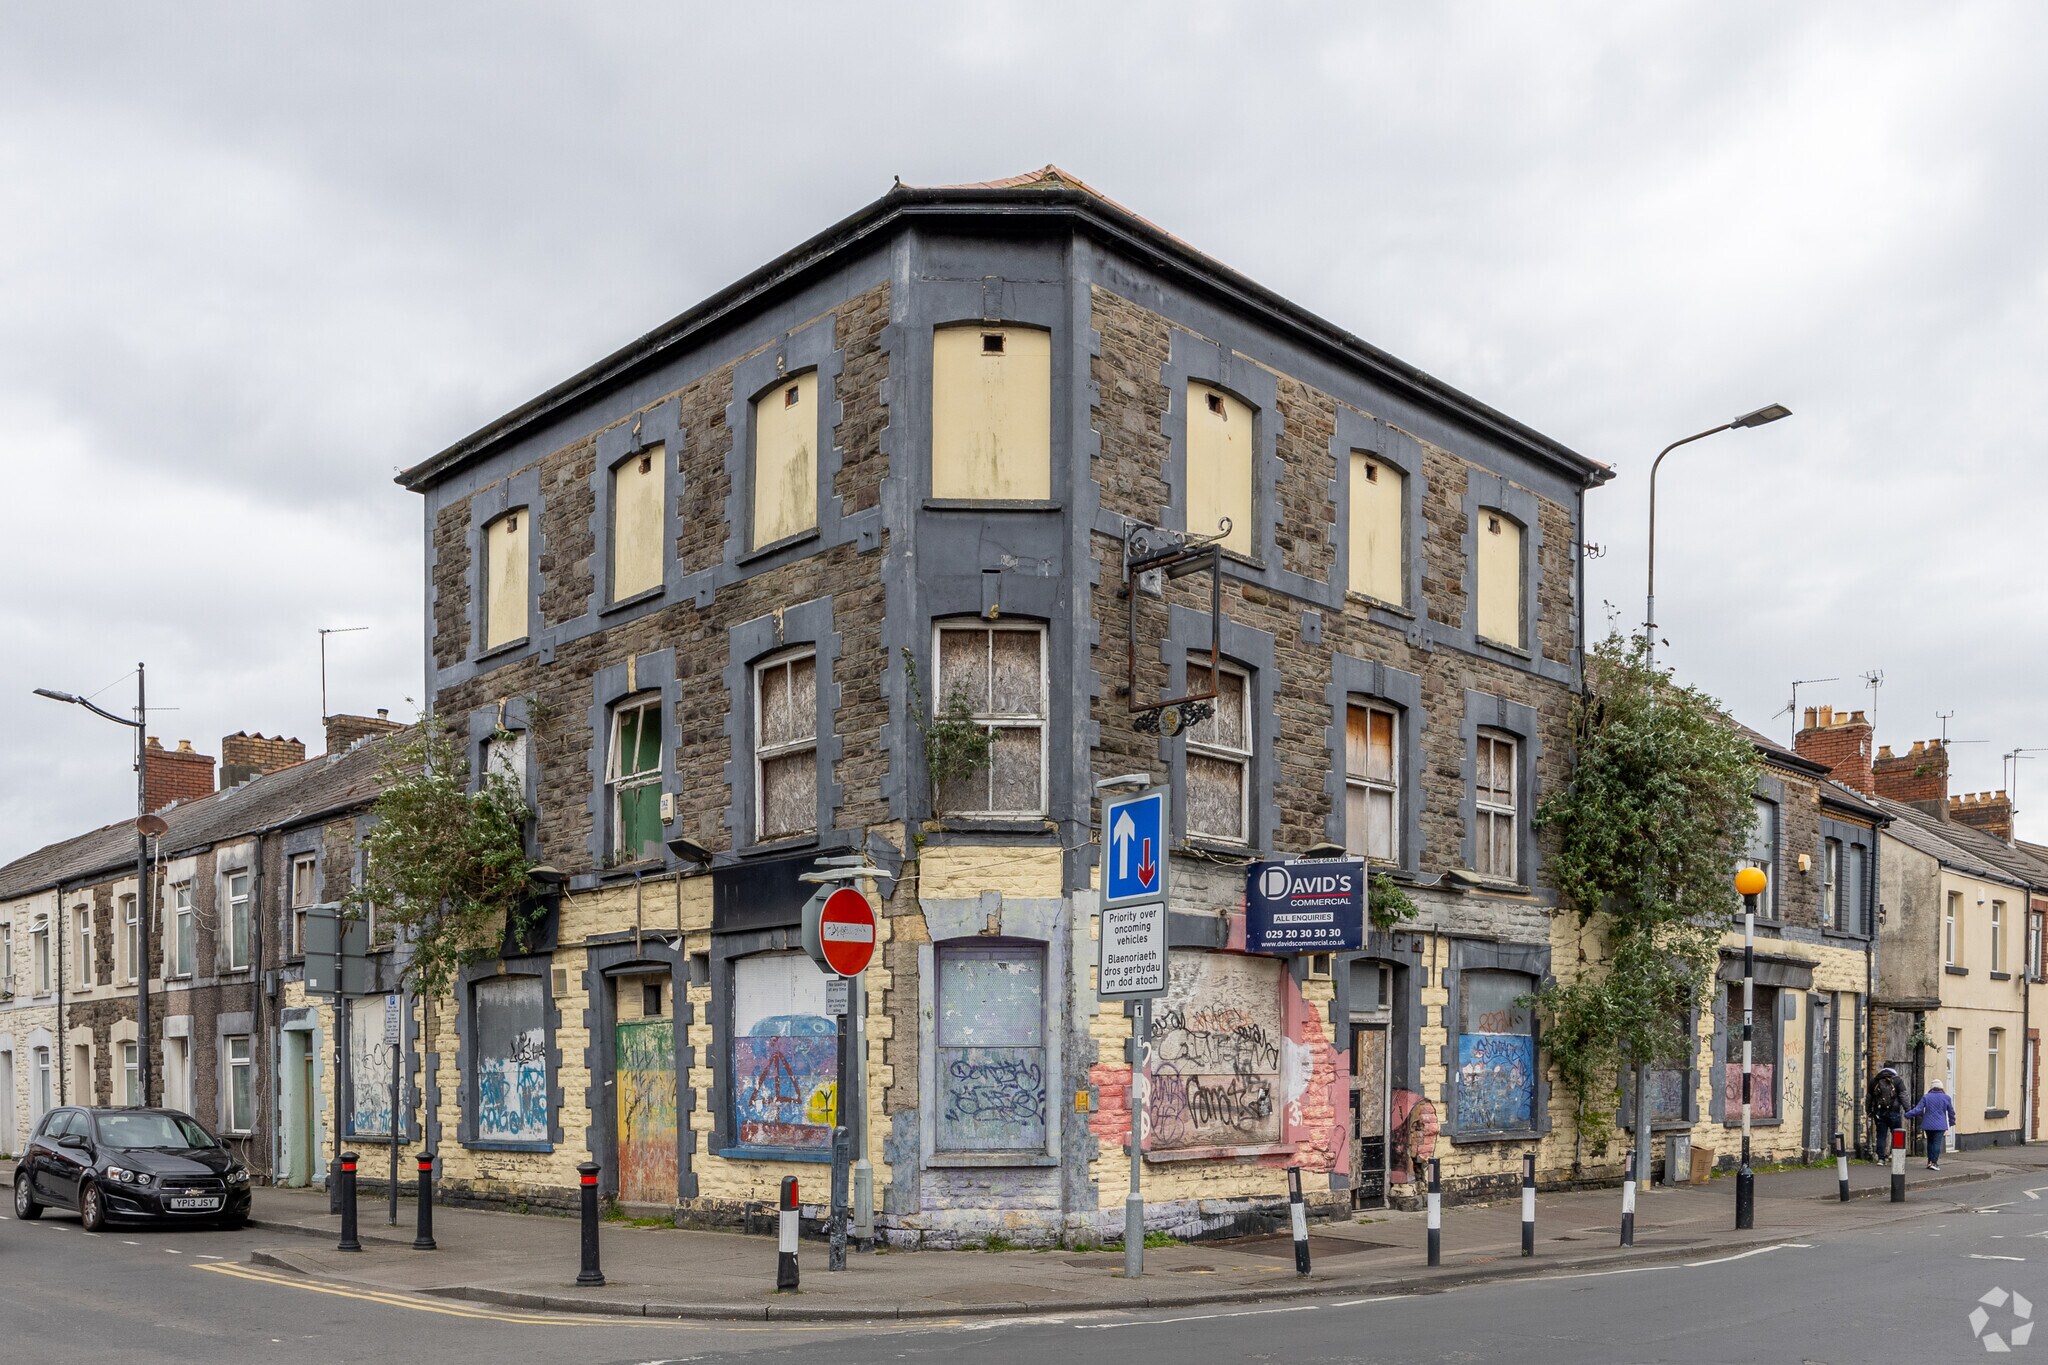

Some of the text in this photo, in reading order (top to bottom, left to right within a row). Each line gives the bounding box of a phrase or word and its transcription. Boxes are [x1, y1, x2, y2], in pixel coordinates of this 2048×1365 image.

[1259, 866, 1352, 901] DAVID'S
[1290, 898, 1351, 907] COMMERCIAL
[1109, 910, 1157, 923] Priority over
[1275, 913, 1332, 922] ALL ENQUIRIES
[1114, 922, 1151, 934] oncoming
[1265, 928, 1341, 939] 029 20 30 30 30
[1116, 934, 1148, 945] vehicles
[1261, 939, 1346, 948] www.davidscommercial.co.uk
[1108, 950, 1157, 964] Blaenoriaeth
[1104, 963, 1160, 976] dros gerbydau
[1106, 974, 1158, 989] yn dod atoch
[1137, 1006, 1142, 1016] 1
